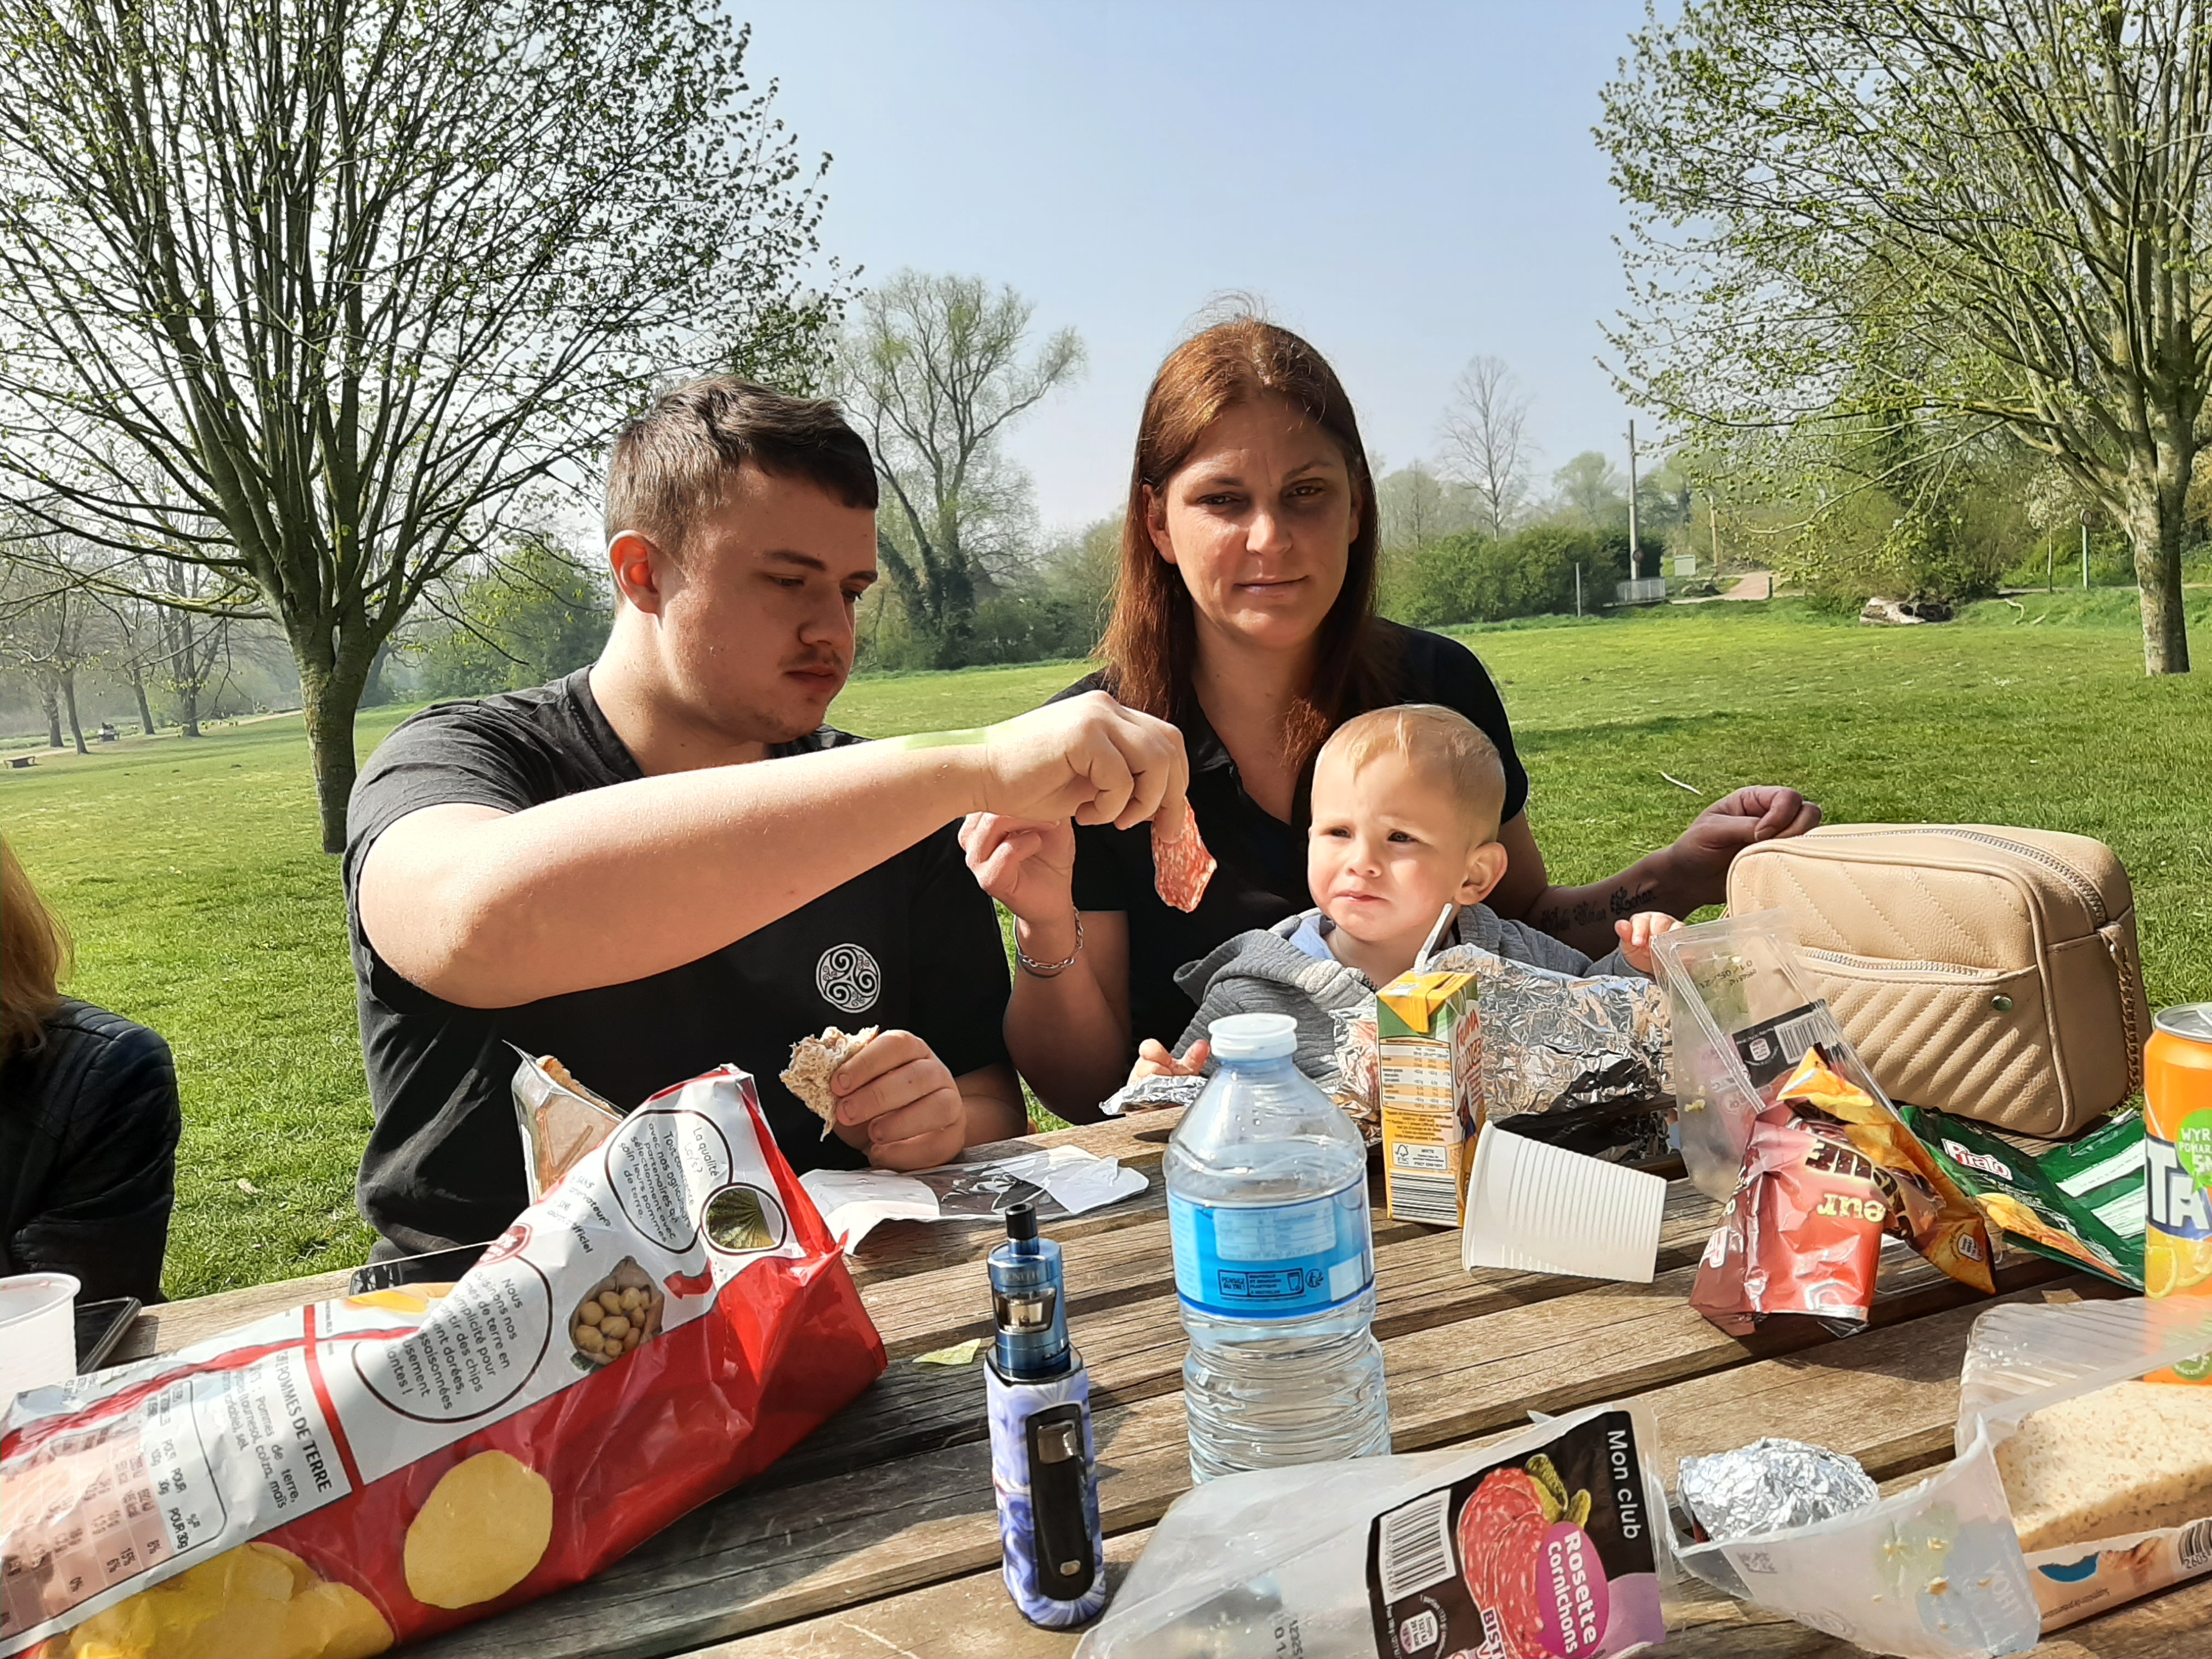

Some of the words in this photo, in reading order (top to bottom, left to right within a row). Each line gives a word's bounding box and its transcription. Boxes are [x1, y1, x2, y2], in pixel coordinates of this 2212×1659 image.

[647, 1122, 661, 1149] avec
[656, 1150, 670, 1171] nos
[662, 1131, 678, 1155] Tout
[692, 1126, 704, 1141] La
[1943, 1139, 2010, 1178] Pirato
[623, 1168, 635, 1184] de
[642, 1141, 673, 1207] partenaires
[666, 1207, 679, 1224] qui
[697, 1142, 722, 1177] qualité
[618, 1142, 636, 1162] soin
[631, 1162, 646, 1192] leurs
[640, 1194, 668, 1243] pommes
[630, 1136, 662, 1212] sélectionnent
[659, 1214, 676, 1240] avec
[501, 1278, 524, 1309] Nous
[478, 1299, 489, 1316] de
[484, 1318, 502, 1350] terre
[498, 1352, 509, 1369] en
[502, 1316, 517, 1340] nos
[400, 1338, 431, 1397] usement
[417, 1329, 454, 1410] ssaisonnées
[443, 1345, 466, 1394] dorées,
[455, 1331, 472, 1357] des
[464, 1356, 483, 1392] chips
[476, 1346, 496, 1378] pour
[255, 1395, 276, 1437] Pommes
[271, 1442, 284, 1461] de
[280, 1468, 300, 1503] terre,
[274, 1366, 302, 1417] POMMES
[291, 1417, 309, 1441] DE
[301, 1440, 332, 1493] TERRE
[1606, 1429, 1629, 1479] Mon
[167, 1466, 189, 1494] POUR
[269, 1479, 289, 1509] maïs
[166, 1506, 187, 1533] POUR
[1617, 1487, 1642, 1539] club
[1547, 1541, 1579, 1654] Cornichons
[1563, 1530, 1600, 1645] Rosette
[1482, 1609, 1505, 1659] BIST
